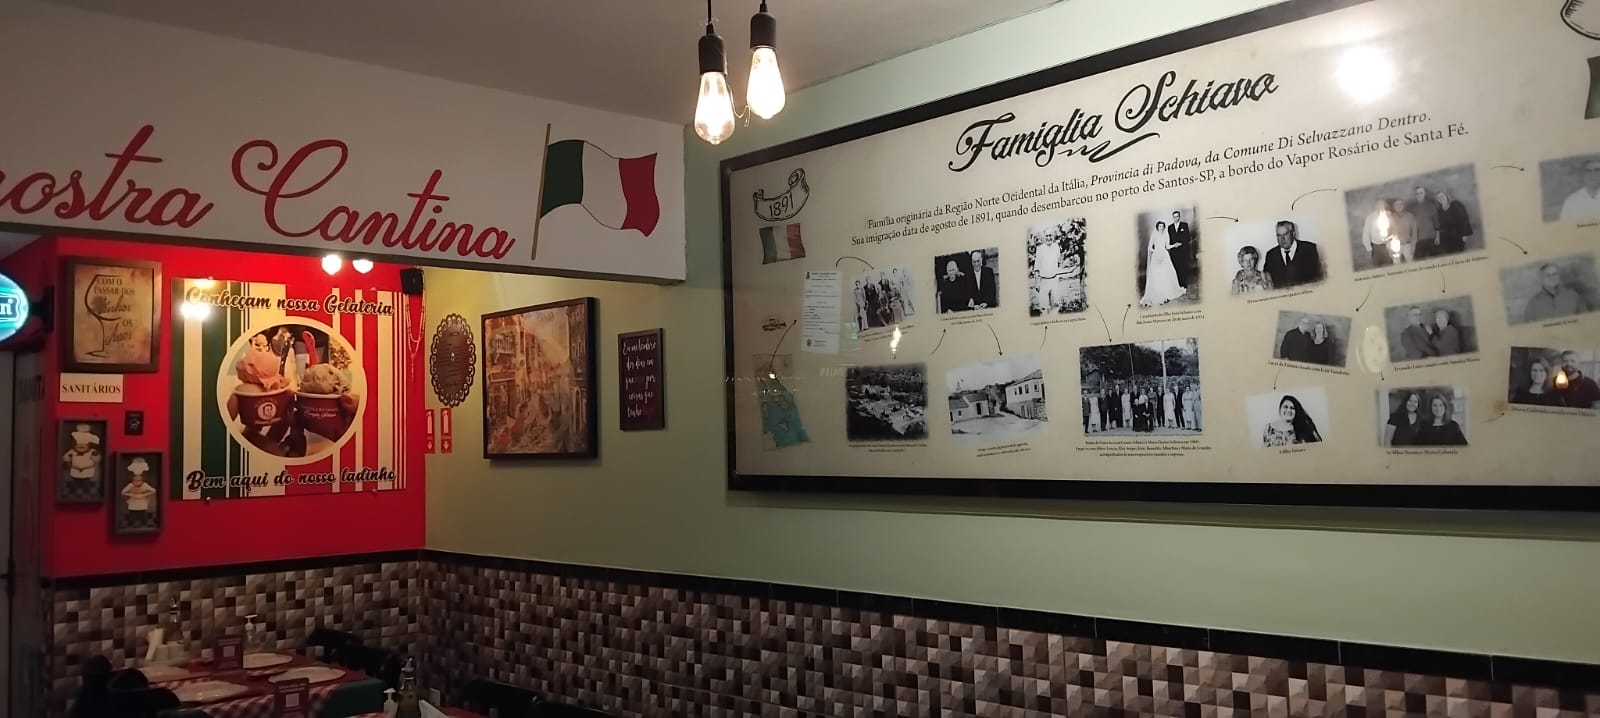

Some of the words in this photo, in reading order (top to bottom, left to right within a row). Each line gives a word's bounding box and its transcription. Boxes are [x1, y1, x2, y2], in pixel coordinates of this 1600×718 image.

[948, 108, 1103, 172] Famiglia
[1114, 70, 1279, 133] Schiavo
[0, 124, 214, 228] ostra
[232, 139, 516, 259] Cantina
[852, 236, 864, 245] Sua
[866, 230, 900, 244] imigração
[902, 227, 918, 236] data
[920, 223, 929, 233] de
[931, 220, 956, 234] agosto
[959, 216, 968, 226] de
[971, 212, 994, 224] 1891,
[996, 205, 1028, 222] quando
[1031, 195, 1093, 213] desembarcou
[1096, 192, 1108, 201] no
[1111, 186, 1140, 202] porto
[1143, 181, 1156, 192] de
[1158, 169, 1216, 190] Santos-SP,
[1219, 170, 1225, 178] a
[1228, 160, 1264, 176] bordo
[1268, 157, 1283, 170] do
[1286, 152, 1324, 168] Vapor
[1328, 140, 1379, 158] Rosário
[1384, 136, 1400, 148] de
[1404, 130, 1443, 145] Santa
[1447, 122, 1469, 138] Fé.
[934, 206, 943, 216] da
[945, 202, 972, 215] Região
[975, 198, 1000, 208] Norte
[1002, 185, 1046, 202] Ocidental
[1048, 183, 1059, 194] da
[1062, 178, 1088, 191] Itália,
[1091, 168, 1139, 186] Provincia
[1143, 164, 1153, 175] di
[1156, 158, 1200, 173] Padova,
[1205, 151, 1220, 163] da
[1224, 142, 1274, 159] Comune
[1277, 136, 1293, 149] Di
[1297, 124, 1372, 146] Selvazzano
[1378, 113, 1431, 130] Dentro.
[769, 192, 793, 217] 1891
[186, 286, 271, 310] Conheçam
[277, 298, 320, 311] nossa
[324, 294, 394, 316] Gelateria
[62, 382, 121, 394] SANITÁRIOS
[187, 470, 226, 492] Bem
[230, 472, 269, 491] aqui
[274, 470, 293, 485] do
[299, 471, 336, 485] nosso
[342, 466, 396, 482] ladinho
